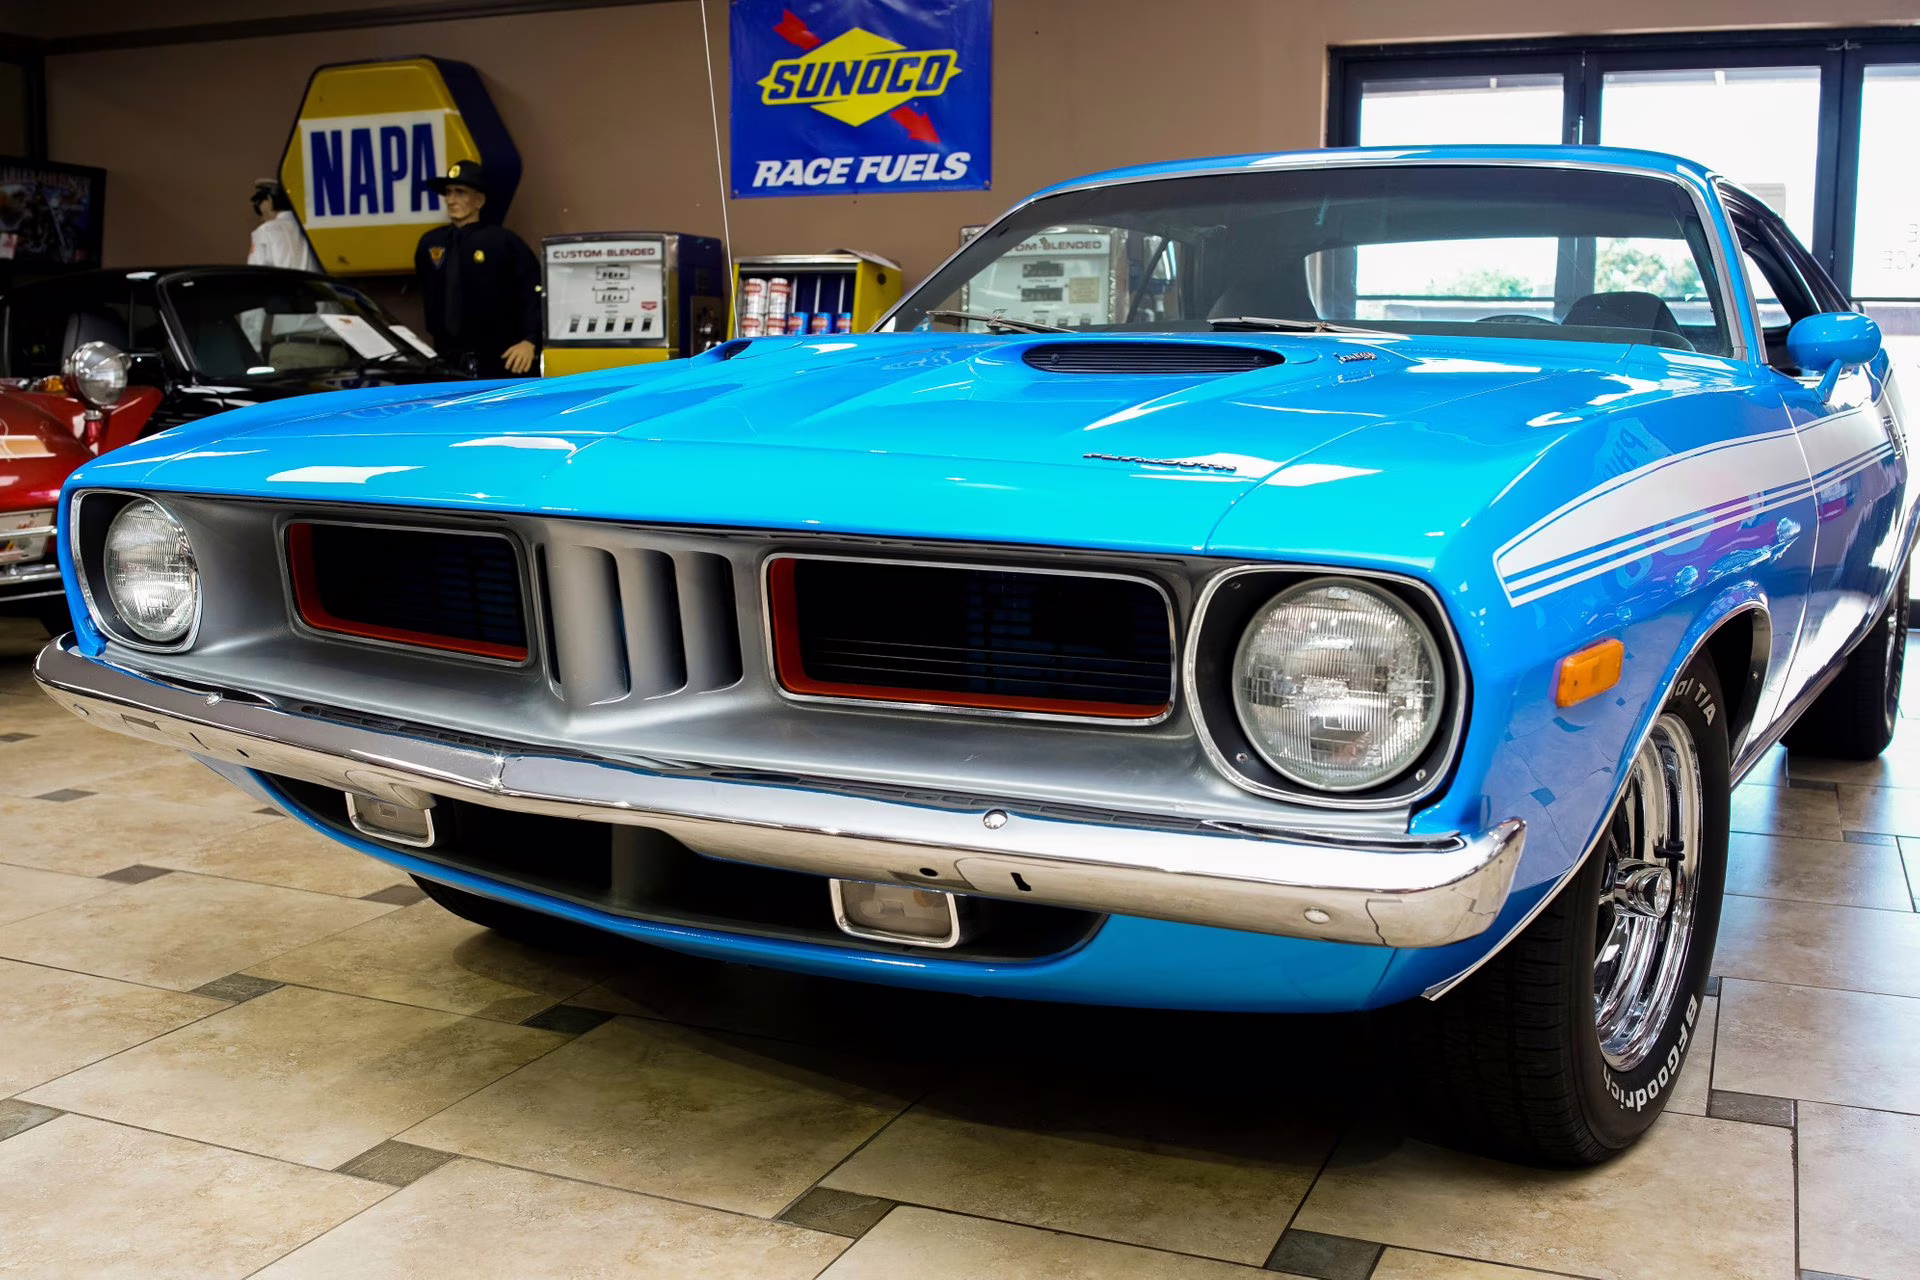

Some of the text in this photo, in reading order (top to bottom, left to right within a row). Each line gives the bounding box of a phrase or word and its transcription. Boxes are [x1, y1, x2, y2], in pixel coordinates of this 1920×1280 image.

[767, 54, 952, 101] SUNOCO
[310, 122, 441, 217] NAPA
[752, 151, 971, 188] RACE FUELS
[552, 247, 656, 259] CUSTOM-BLENDED
[1694, 682, 1717, 727] T/A
[1602, 993, 1699, 1113] BFGoodrich
